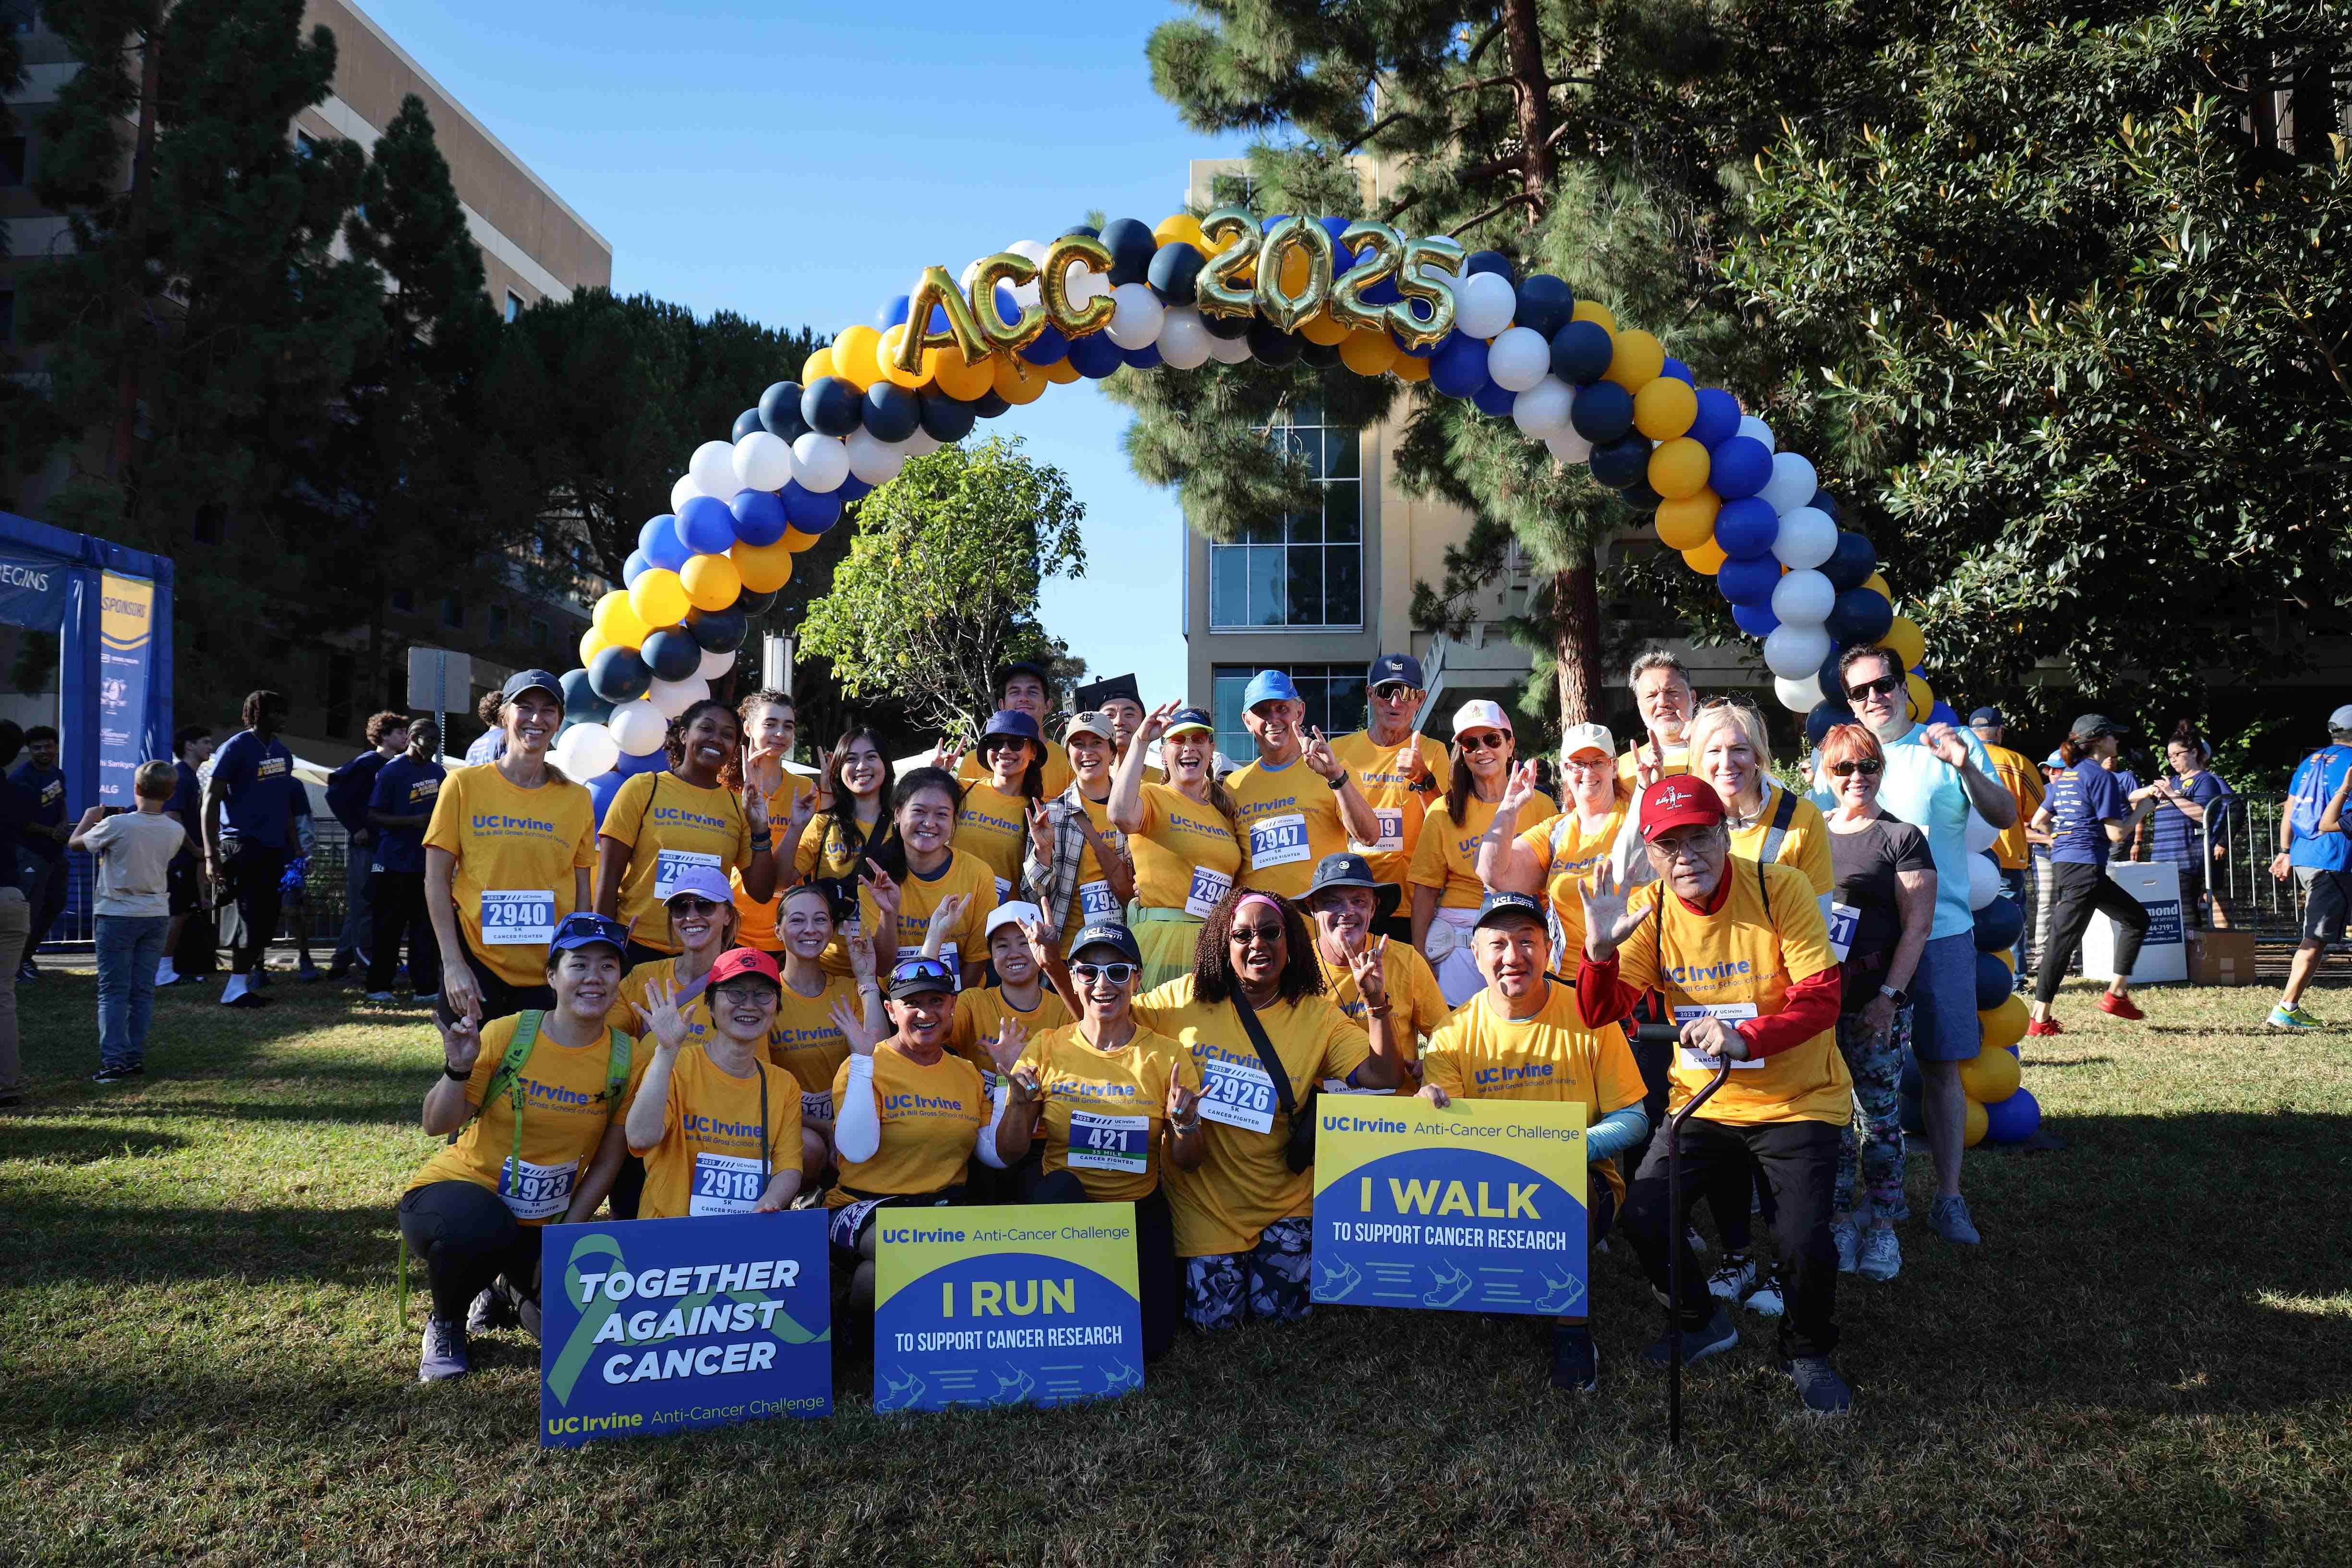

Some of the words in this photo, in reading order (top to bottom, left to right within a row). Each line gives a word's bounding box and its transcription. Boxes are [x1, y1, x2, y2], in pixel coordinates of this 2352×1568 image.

[893, 234, 1117, 377] ACC
[1196, 207, 1467, 351] 2025
[0, 564, 49, 591] EGINS
[1362, 772, 1404, 783] Irvine
[1253, 796, 1297, 813] Irvine
[473, 815, 500, 828] UC
[503, 816, 554, 832] Irvine
[654, 807, 679, 819] UC
[681, 810, 726, 828] Irvine
[979, 813, 1020, 832] Irvine
[1170, 813, 1191, 827] UC
[1379, 818, 1395, 837] 19
[1256, 826, 1298, 853] 2947
[1458, 836, 1479, 852] UC
[1087, 892, 1119, 912] 293
[2146, 903, 2178, 917] mond
[489, 903, 546, 926] 2940
[1084, 927, 1100, 936] UCI
[1102, 929, 1123, 937] Challenge
[1689, 960, 1751, 982] Irvine
[1718, 979, 1742, 989] School
[770, 1029, 794, 1045] UC
[797, 1026, 842, 1041] Irvine
[1192, 1042, 1219, 1059] UC
[1220, 1048, 1264, 1070] Irvin
[1475, 1068, 1499, 1084] UC
[1502, 1062, 1553, 1081] Irvine
[529, 1080, 588, 1106] Irvine
[1051, 1082, 1078, 1094] UC
[1080, 1082, 1136, 1096] Irvine
[1206, 1075, 1270, 1111] 2926
[528, 1099, 549, 1109] Gross
[551, 1104, 576, 1113] School
[885, 1094, 912, 1110] UC
[914, 1094, 962, 1111] Irvine
[683, 1114, 710, 1132] UC
[712, 1118, 763, 1138] Irvine
[1207, 1108, 1232, 1119] CANCER
[1233, 1115, 1260, 1126] FIGHTER
[1088, 1128, 1128, 1152] 421
[1322, 1116, 1350, 1131] UC
[1353, 1117, 1407, 1134] Irvine
[1413, 1121, 1502, 1138] Anti-Cancer
[1506, 1124, 1580, 1142] Challenge
[714, 1137, 730, 1145] Gross
[700, 1169, 759, 1200] 2918
[1360, 1176, 1372, 1213] I
[1388, 1177, 1542, 1220] WALK
[882, 1229, 910, 1243] UC
[912, 1228, 966, 1243] Irvine
[972, 1229, 1057, 1242] Anti-Cancer
[1060, 1226, 1130, 1241] Challenge
[1332, 1221, 1351, 1241] TO
[1355, 1222, 1421, 1245] SUPPORT
[1424, 1226, 1484, 1248] CANCER
[1487, 1228, 1567, 1251] RESEARCH
[578, 1259, 800, 1304] TOGETHER
[942, 1282, 954, 1318] I
[970, 1278, 1075, 1317] RUN
[592, 1299, 785, 1344] AGAINST
[895, 1332, 913, 1352] TO
[917, 1330, 983, 1351] SUPPORT
[986, 1328, 1044, 1349] CANCER
[1047, 1325, 1123, 1347] RESEARCH
[602, 1341, 777, 1385] CANCER
[548, 1416, 580, 1435] UC
[582, 1412, 643, 1432] Irvine
[651, 1403, 745, 1425] Anti-Cancer
[750, 1396, 825, 1415] Challenge
